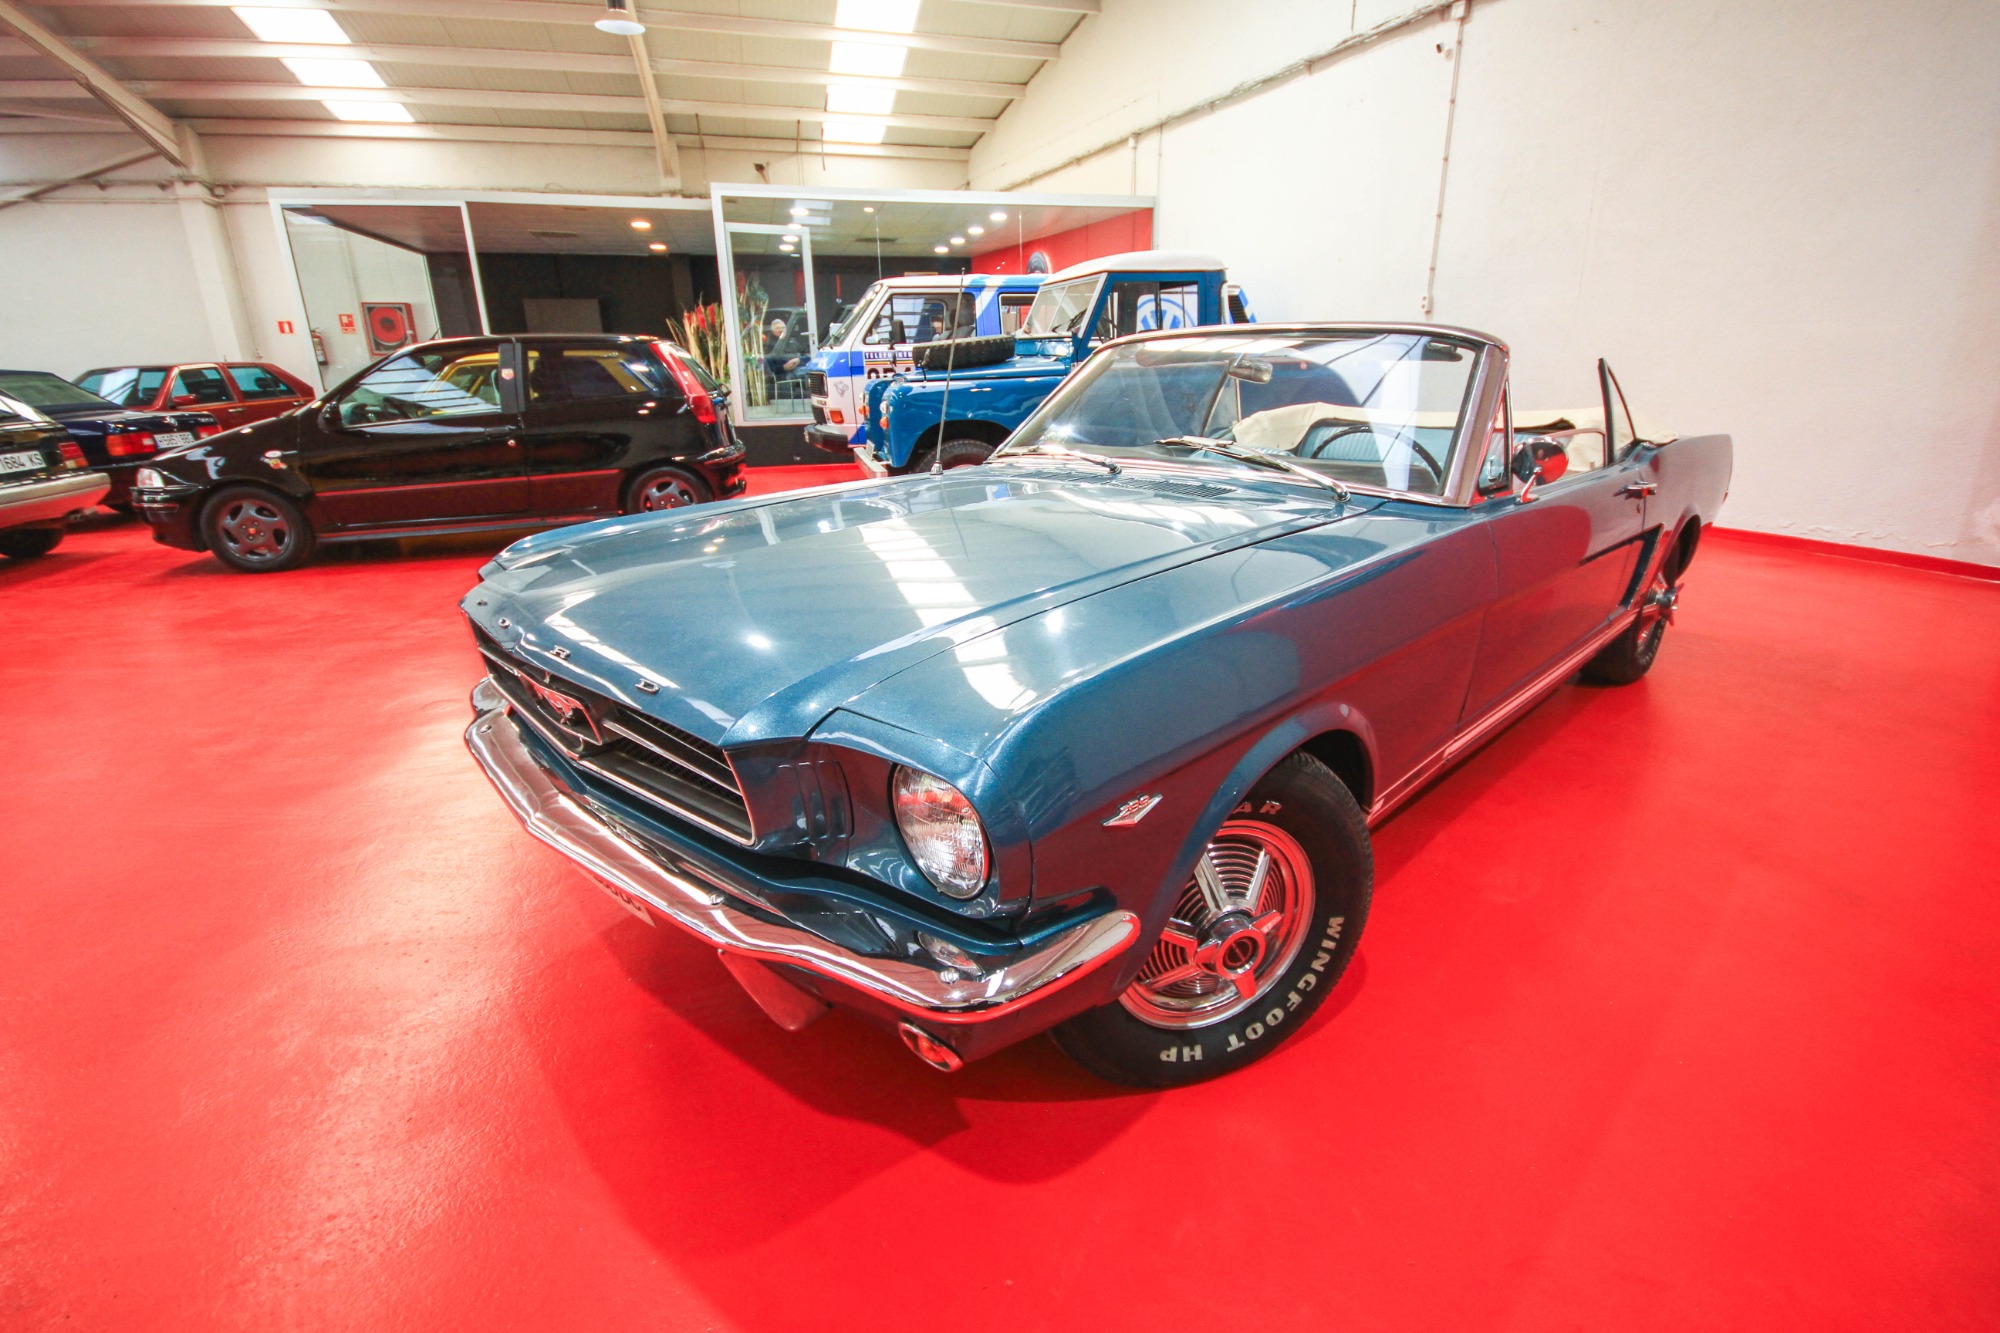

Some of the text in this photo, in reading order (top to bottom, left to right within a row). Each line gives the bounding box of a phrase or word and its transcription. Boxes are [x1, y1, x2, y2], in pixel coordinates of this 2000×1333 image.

[865, 351, 913, 359] TELEFUKEN
[27, 453, 43, 467] KS
[1160, 916, 1345, 1062] WINGFOOT HP
